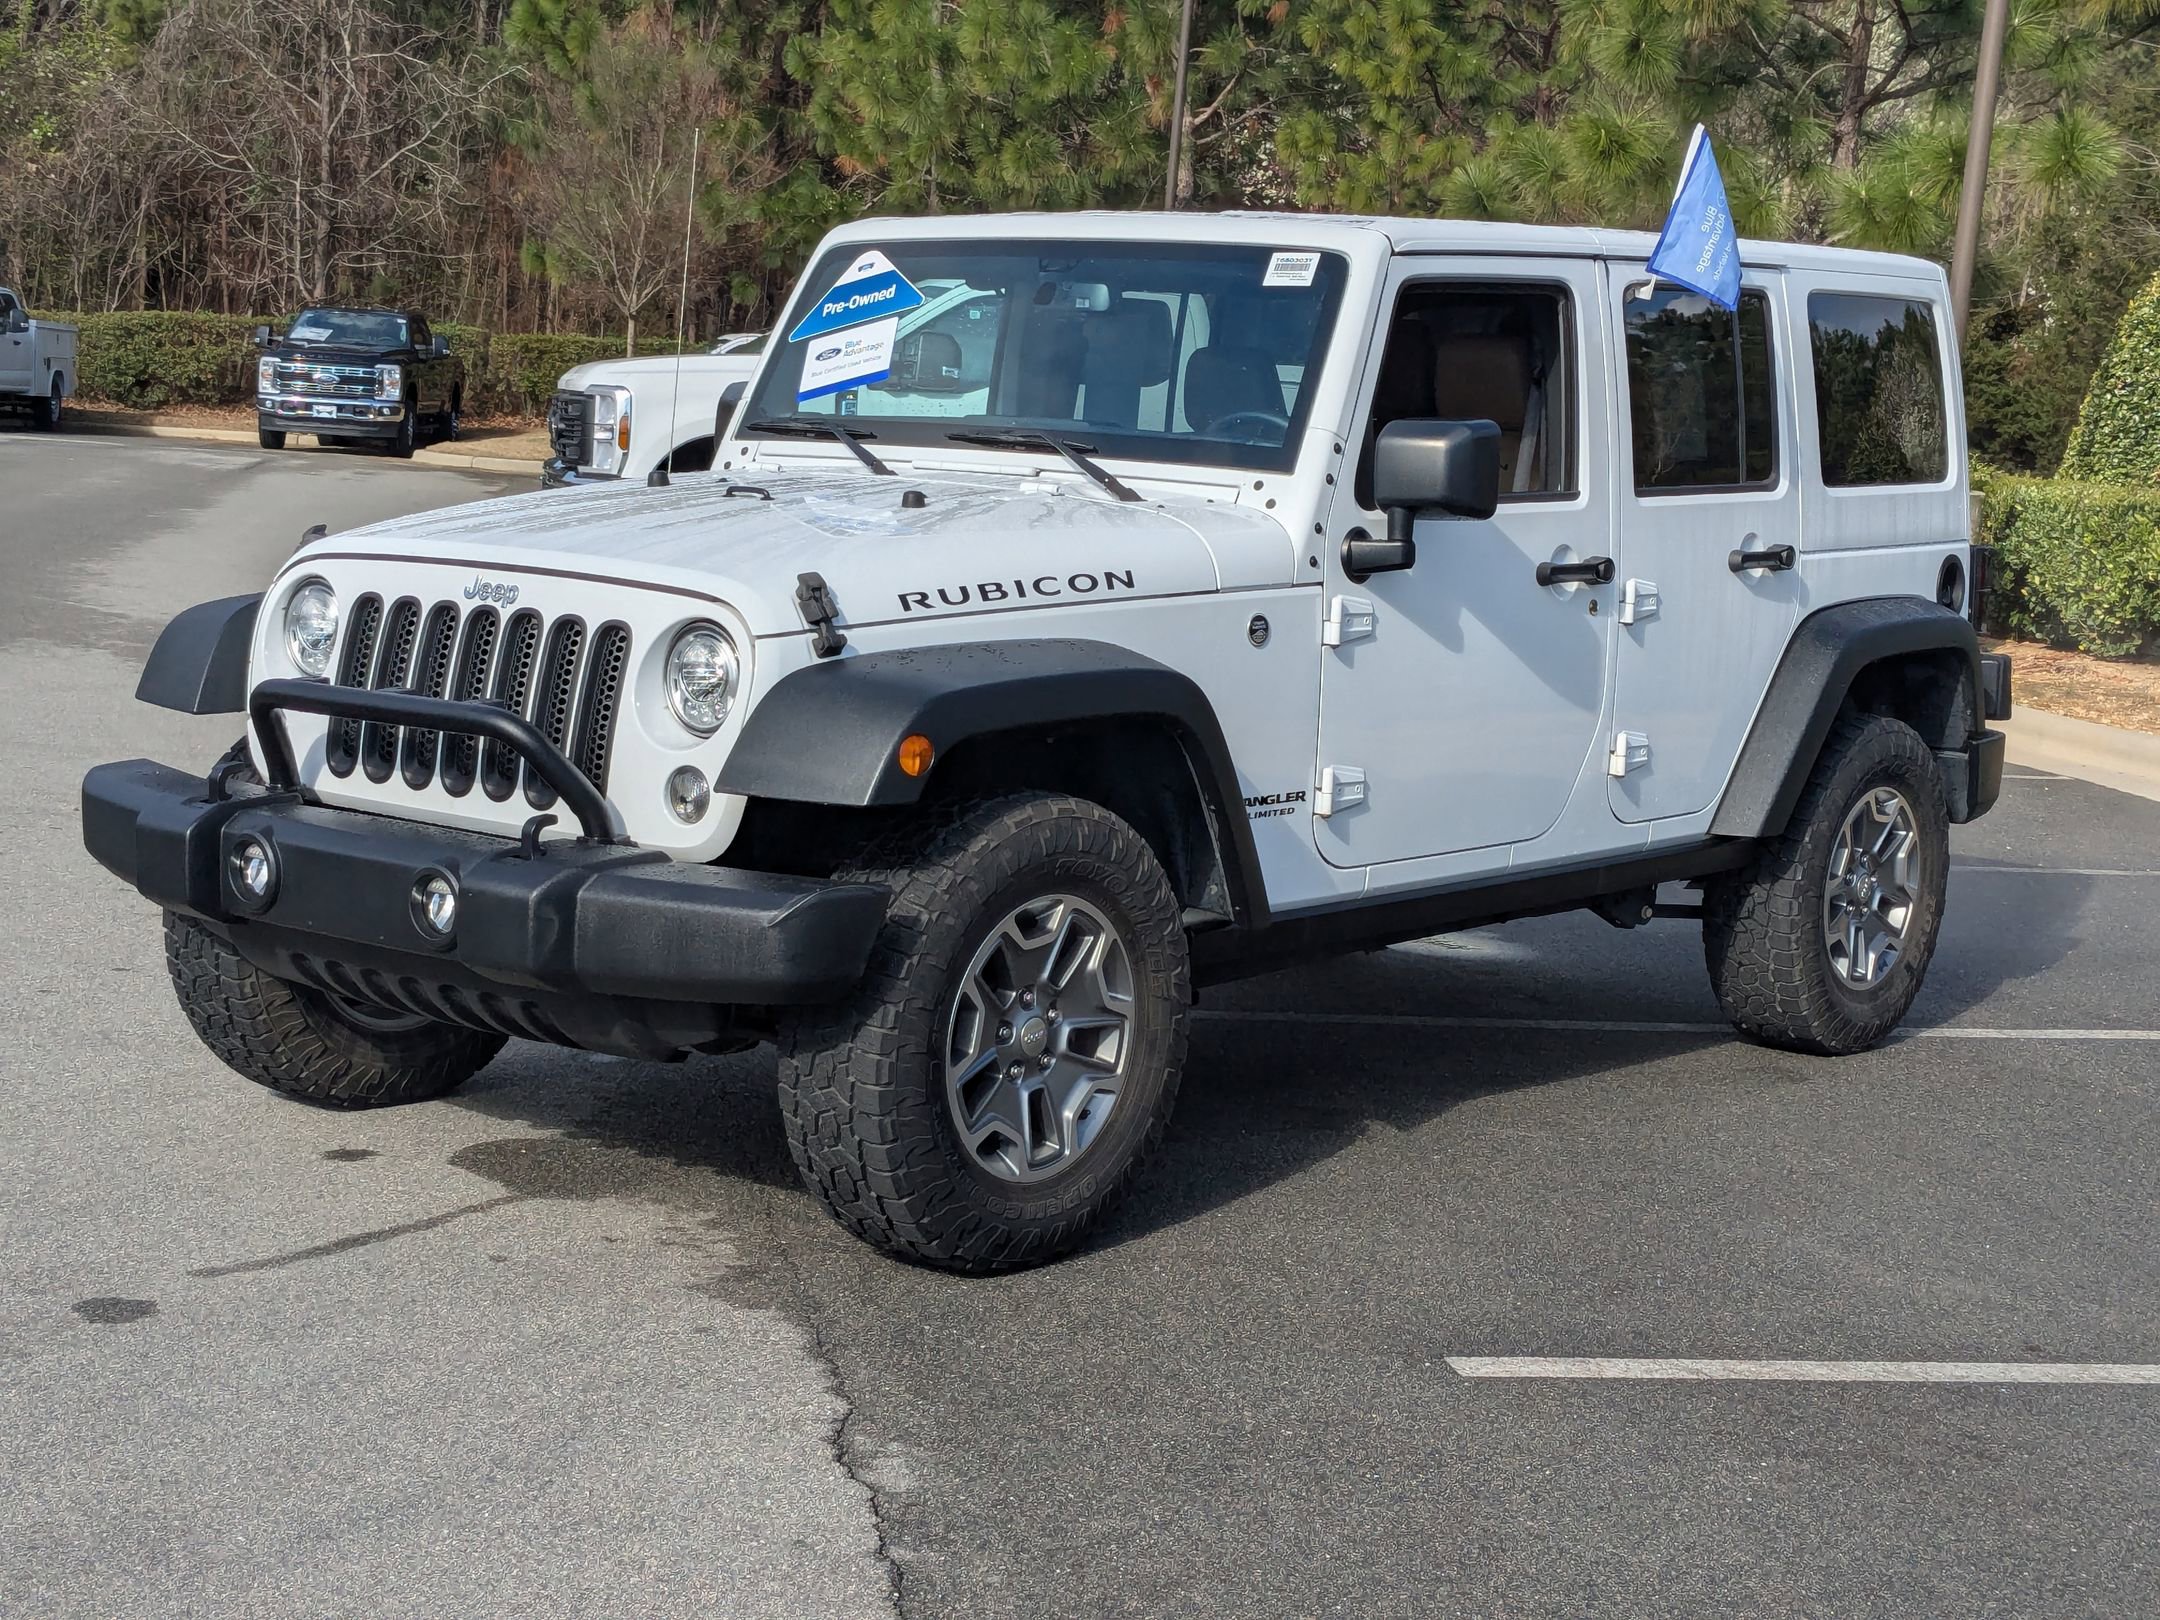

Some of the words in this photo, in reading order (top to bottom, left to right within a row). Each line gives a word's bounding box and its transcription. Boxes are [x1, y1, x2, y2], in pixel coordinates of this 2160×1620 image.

[823, 284, 896, 317] Pre-Owned
[844, 342, 884, 357] Advantage
[845, 340, 862, 350] Blue
[464, 575, 519, 608] Jeep
[897, 570, 1135, 612] RUBICON
[1243, 791, 1306, 807] ANGLER
[1248, 807, 1295, 819] LIMITED
